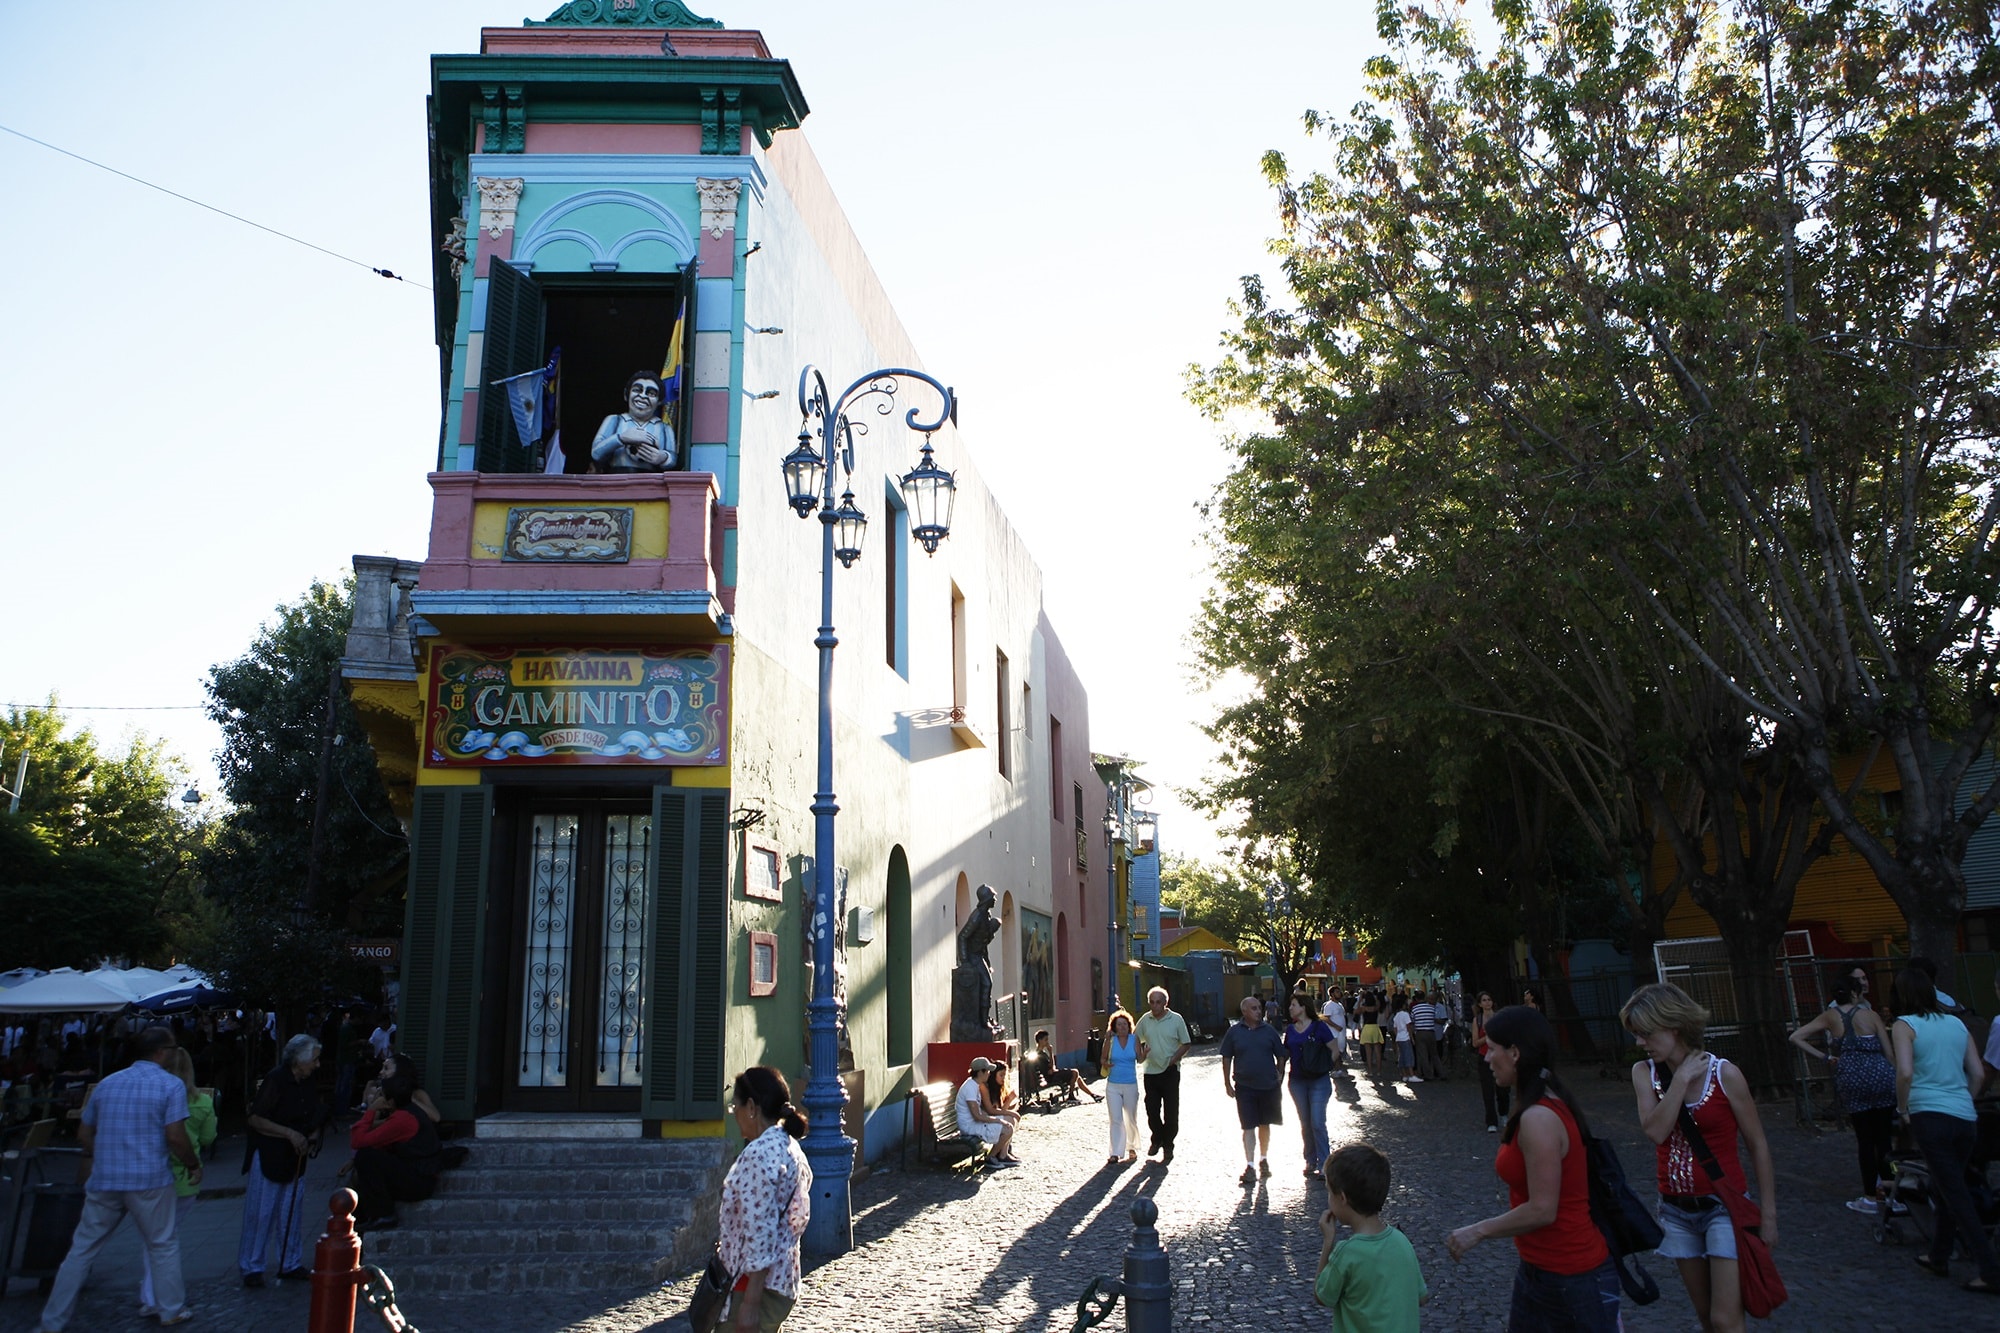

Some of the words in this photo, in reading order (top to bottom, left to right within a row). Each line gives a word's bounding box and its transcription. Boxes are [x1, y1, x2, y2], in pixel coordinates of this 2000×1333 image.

[522, 660, 633, 681] HAVANNA
[454, 695, 462, 708] H
[474, 684, 681, 726] CAMINITO
[691, 694, 701, 706] H
[544, 731, 580, 748] DESDE
[582, 731, 605, 748] 1948
[350, 946, 391, 958] TANGO
